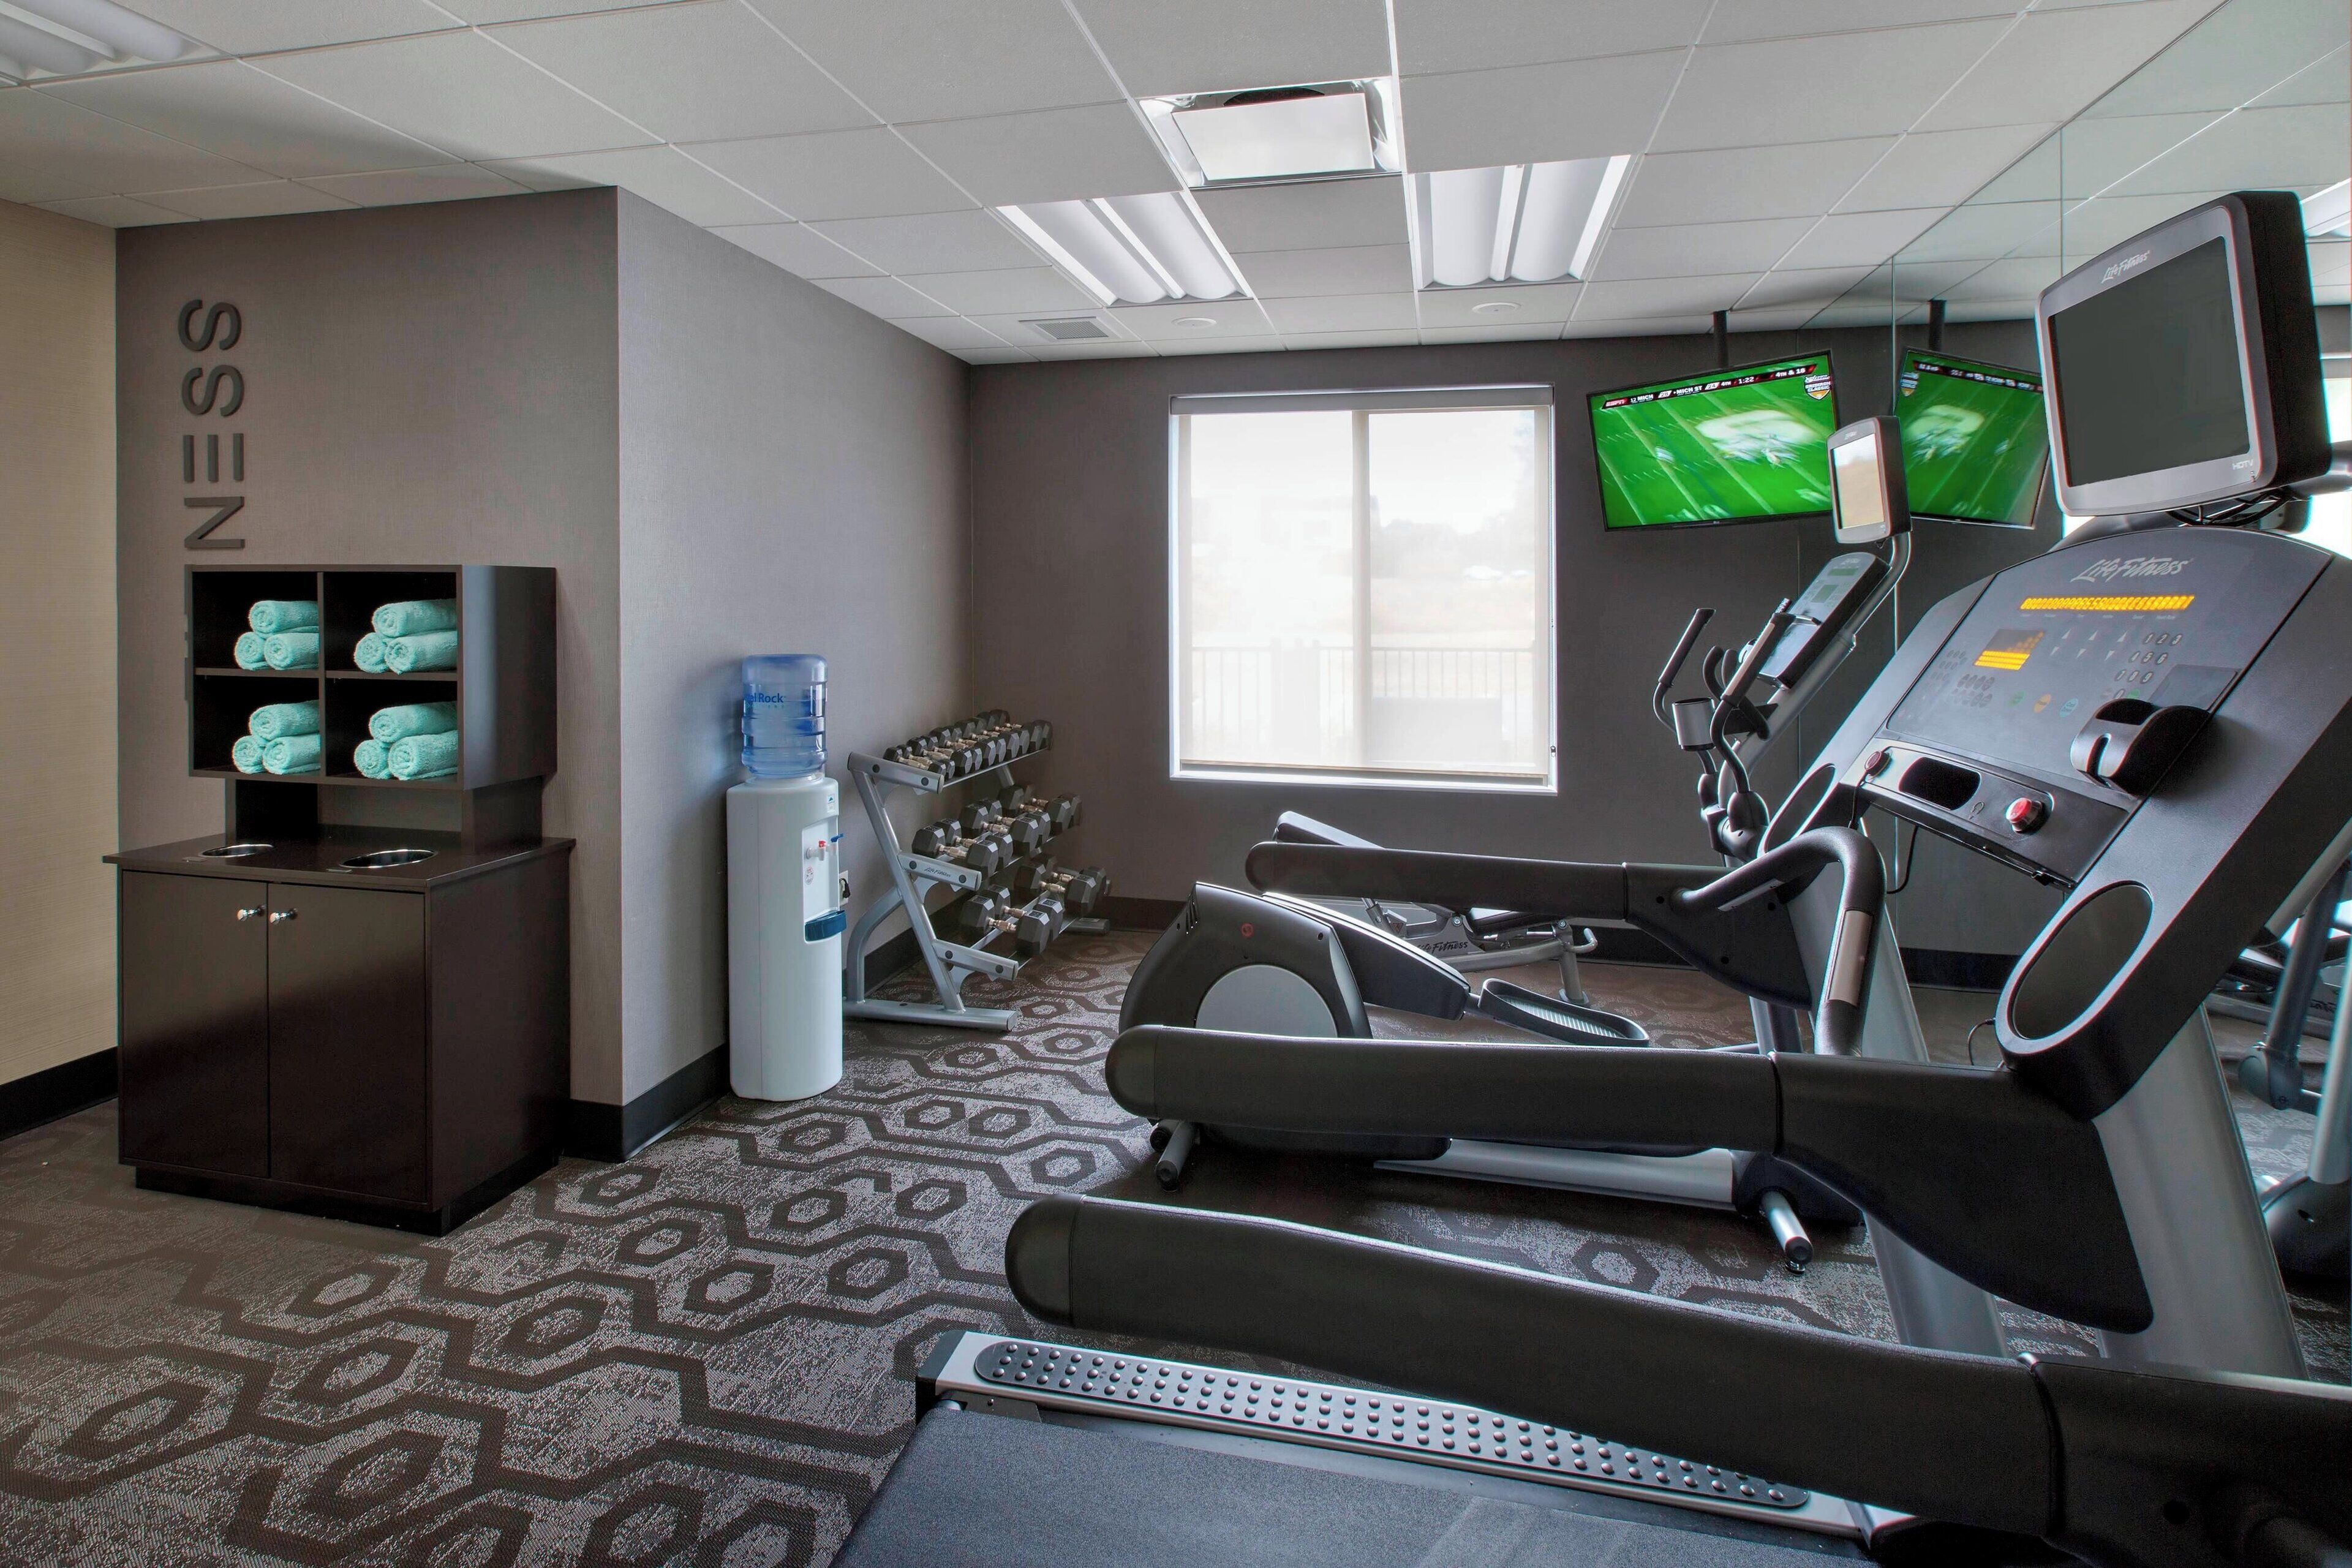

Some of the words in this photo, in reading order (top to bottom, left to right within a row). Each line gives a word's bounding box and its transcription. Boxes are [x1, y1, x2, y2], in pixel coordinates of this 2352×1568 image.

[2117, 254, 2148, 276] Fitness
[2070, 558, 2121, 583] Life
[2105, 557, 2189, 583] Fitness
[759, 693, 784, 703] Rock
[1431, 941, 1469, 954] Fitness
